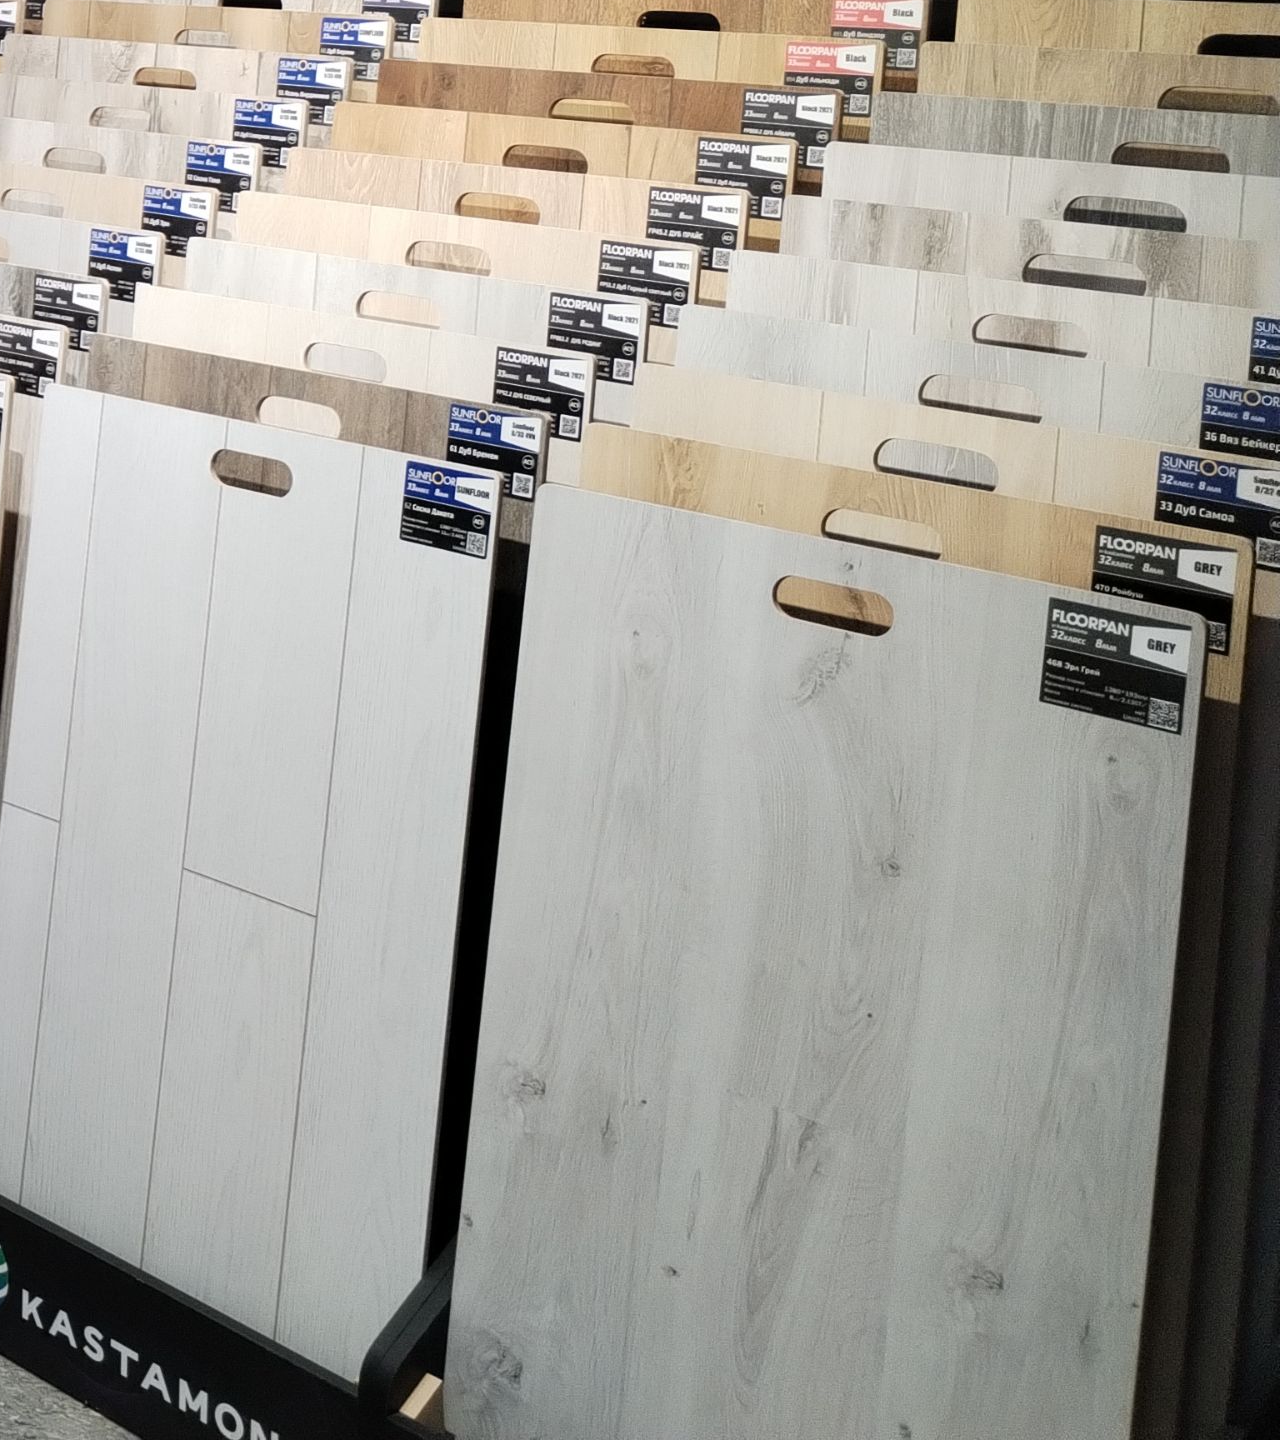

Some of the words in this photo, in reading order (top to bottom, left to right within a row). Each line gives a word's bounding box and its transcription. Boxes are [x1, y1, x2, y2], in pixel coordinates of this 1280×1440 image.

[835, 0, 885, 10] FLOORPAN
[787, 45, 838, 57] FLOORPAN
[745, 92, 795, 105] FLOORPAN
[699, 141, 750, 154] FLOORPAN
[650, 190, 701, 205] FLOORPAN
[602, 244, 653, 260] FLOORPAN
[552, 296, 602, 312] FLOORPAN
[498, 350, 548, 368] FLOORPAN
[451, 407, 502, 425] SUNFLOOR
[1204, 431, 1218, 442] 36
[1219, 433, 1239, 445] Вяз
[1162, 455, 1237, 478] SUNFLOOR
[408, 468, 456, 486] SUNFLOOR
[1159, 500, 1173, 512] 33
[1174, 503, 1197, 517] Дуб
[1199, 507, 1235, 523] Самоа
[1099, 534, 1177, 561] FLOORPAN
[1194, 560, 1223, 577] GREY
[1052, 608, 1130, 637] FLOORPAN
[1146, 638, 1177, 655] GREY
